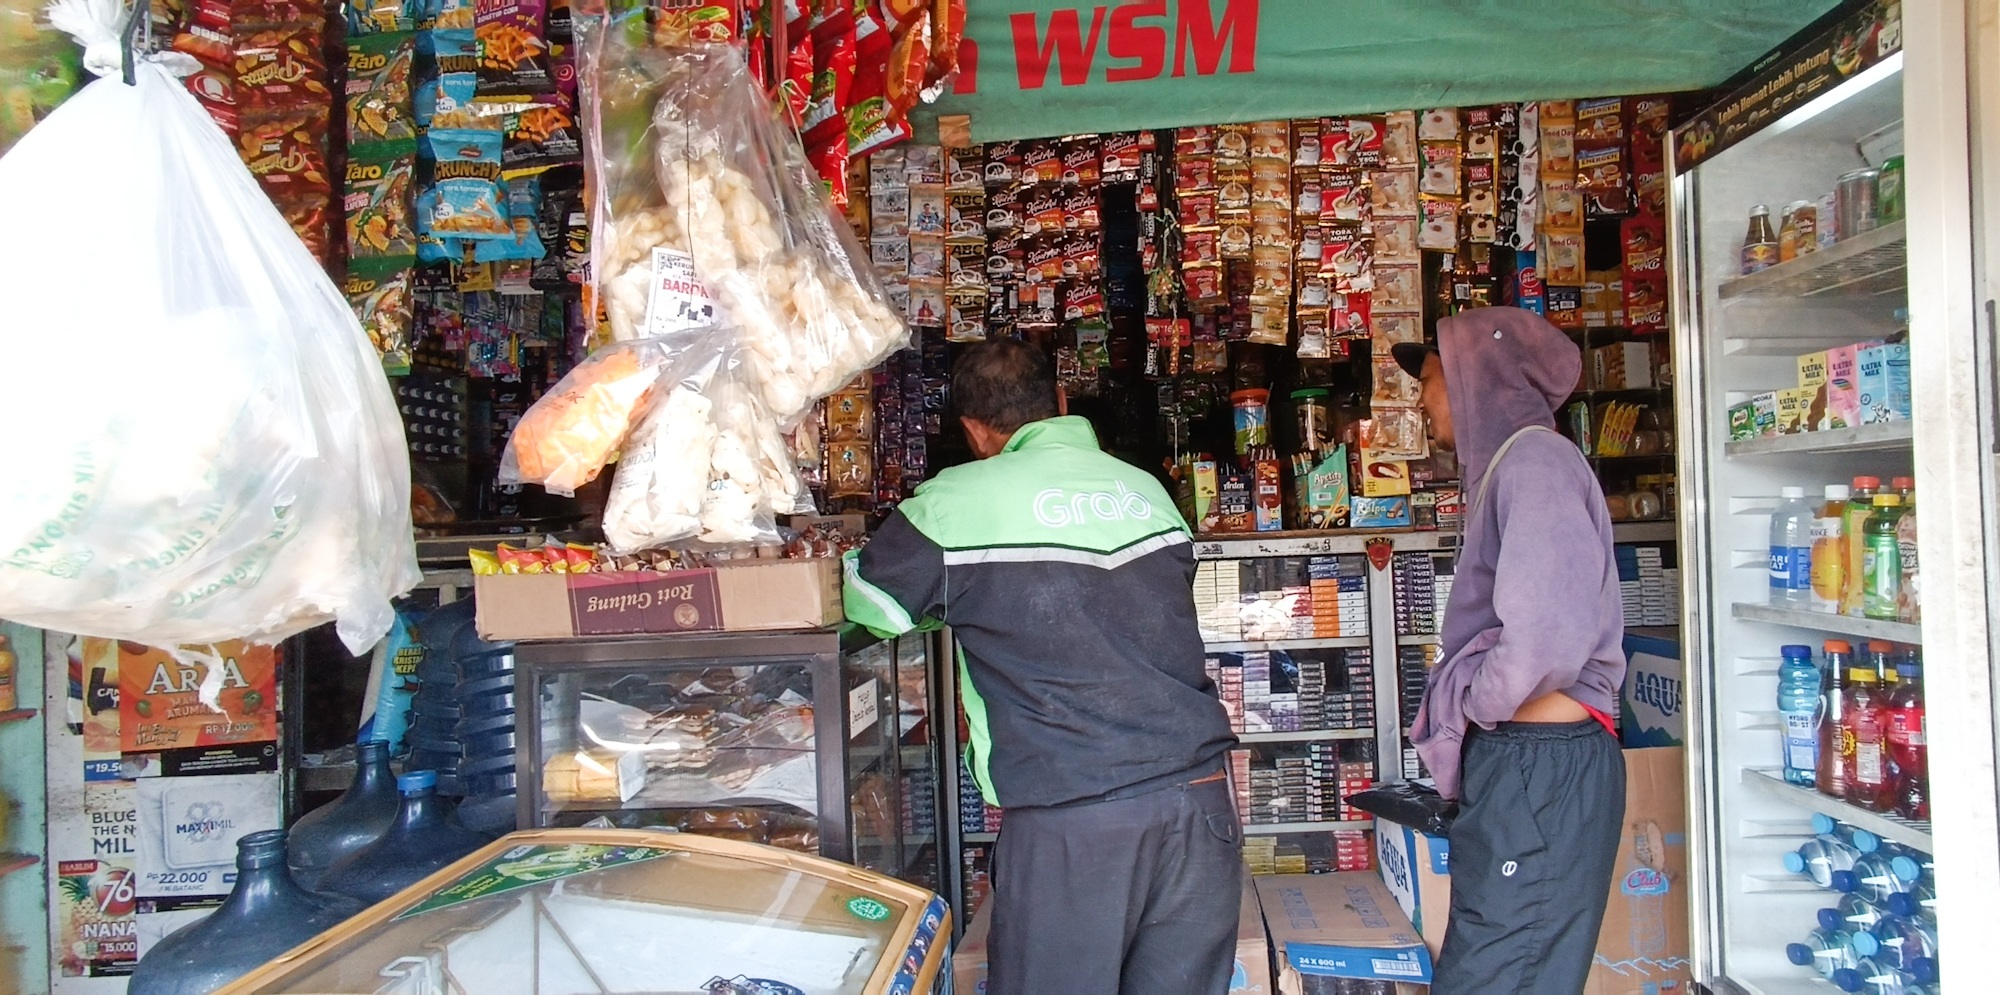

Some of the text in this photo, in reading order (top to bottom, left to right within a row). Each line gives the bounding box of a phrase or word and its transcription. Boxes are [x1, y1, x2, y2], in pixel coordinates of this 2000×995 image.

[1009, 0, 1260, 90] WSM
[347, 53, 386, 69] Taro
[1718, 104, 1740, 125] Lebih
[1769, 69, 1794, 92] Lebih
[1794, 48, 1830, 76] Untung
[1581, 104, 1619, 117] ENERGEN
[950, 145, 983, 156] ABC
[1441, 148, 1456, 156] Day
[1581, 154, 1618, 165] ENERGEN
[345, 163, 382, 179] Taro
[434, 162, 502, 180] CRUNCHY
[951, 195, 983, 205] ABC
[1441, 203, 1456, 211] Day
[952, 244, 984, 255] ABC
[951, 294, 985, 305] ABC
[1801, 364, 1824, 374] ULTRA
[1861, 360, 1882, 371] ULTRA
[1805, 371, 1821, 379] MILK
[1864, 368, 1881, 377] MILK
[1032, 483, 1152, 527] Grab
[1367, 536, 1392, 546] WSM
[588, 584, 695, 614] Roti Gulung
[146, 657, 249, 695] ARA
[92, 826, 119, 836] THE
[176, 819, 236, 834] MAXXIMIL
[1381, 832, 1409, 893] AQUA
[1627, 871, 1662, 889] Club
[100, 870, 134, 914] 76
[1299, 957, 1311, 965] 24
[1310, 957, 1318, 965] X
[1318, 958, 1335, 968] 600
[1335, 960, 1347, 968] ml
